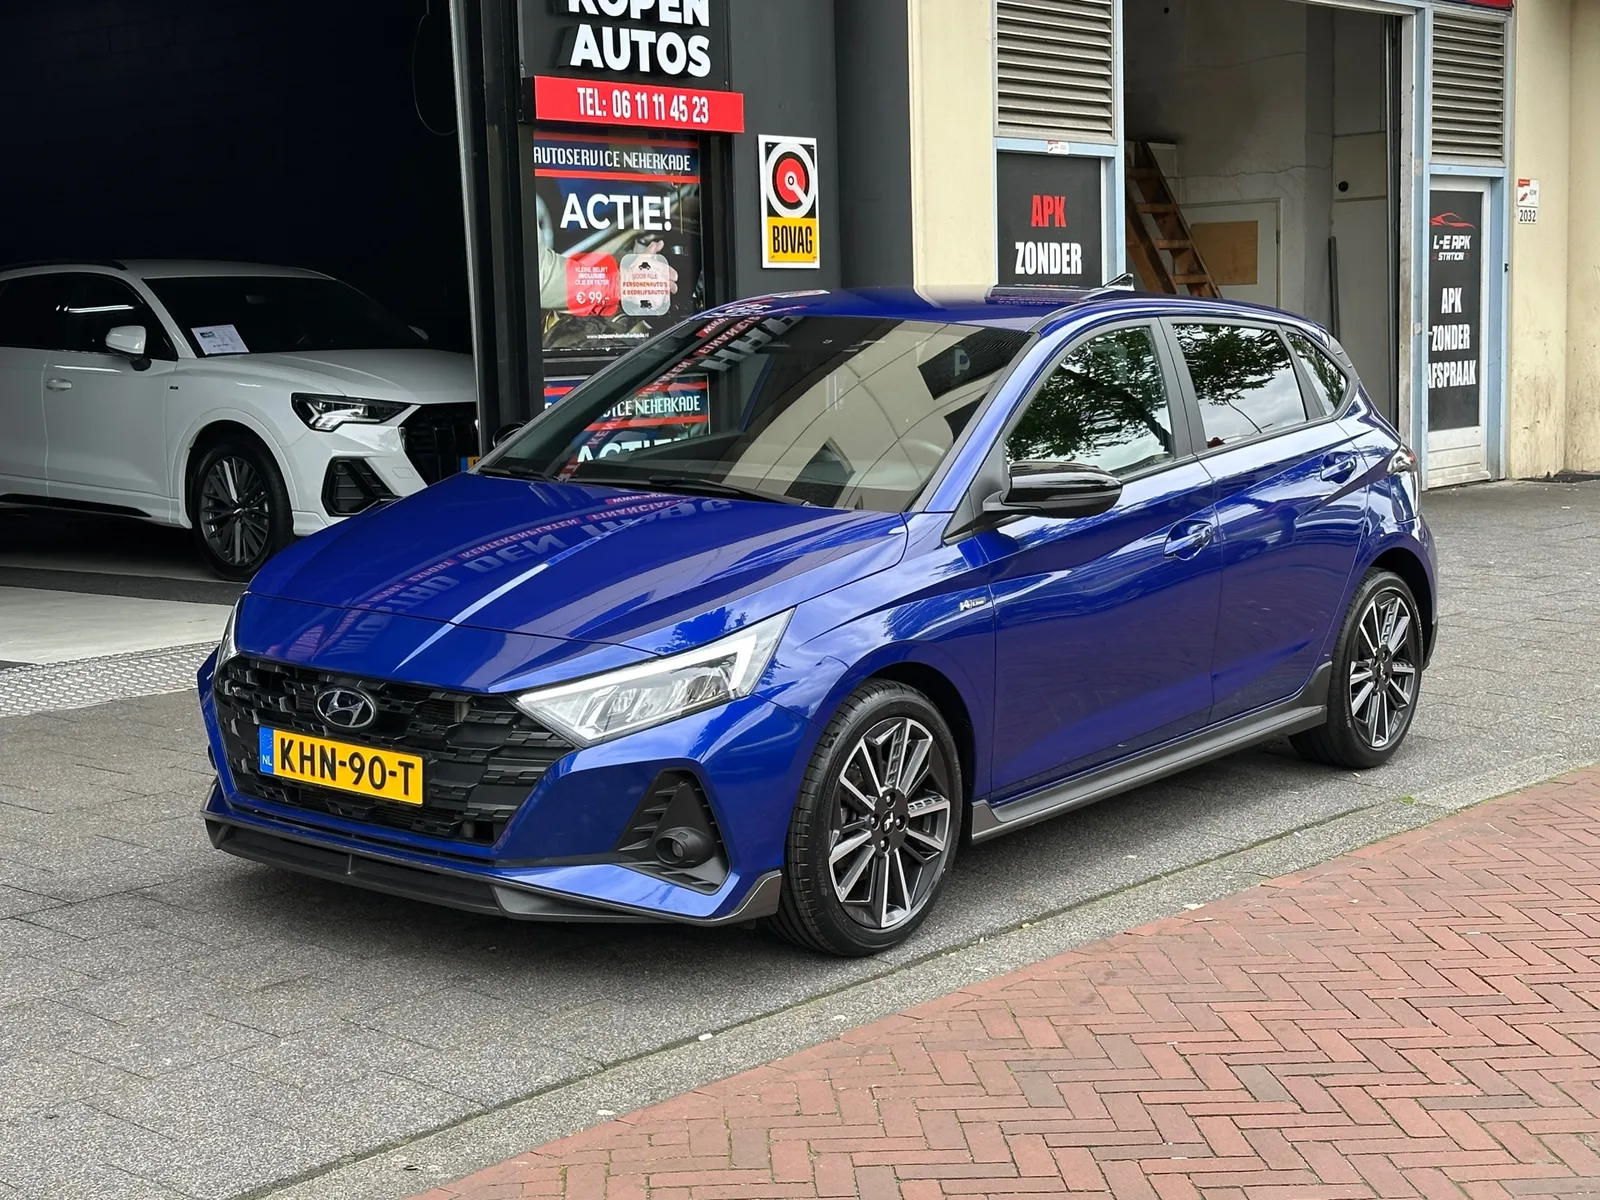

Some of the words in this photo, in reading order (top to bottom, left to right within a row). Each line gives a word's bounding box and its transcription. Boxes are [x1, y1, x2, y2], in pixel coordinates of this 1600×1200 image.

[569, 23, 711, 78] AUTOS
[577, 87, 607, 117] TEL:
[612, 89, 631, 119] 06
[635, 92, 648, 120] 11
[652, 93, 665, 121] 11
[669, 95, 688, 123] 45
[692, 96, 709, 124] 23
[533, 146, 620, 168] AUTOSERVICE
[623, 151, 691, 171] NEHERKADE
[560, 192, 672, 231] ACTIE!
[1030, 194, 1067, 228] APK
[1519, 209, 1536, 222] 2032
[772, 225, 813, 254] BOVAG
[1451, 235, 1471, 249] APK
[1014, 241, 1082, 275] ZONDER
[1438, 251, 1465, 261] STATION
[576, 291, 586, 304] €
[1441, 287, 1462, 314] APK
[1431, 324, 1470, 351] ZONDER
[1428, 360, 1476, 388] AFSPRAAK
[635, 395, 701, 415] NEHERKADE
[262, 755, 272, 766] NL
[280, 737, 415, 796] KHN-90-T
